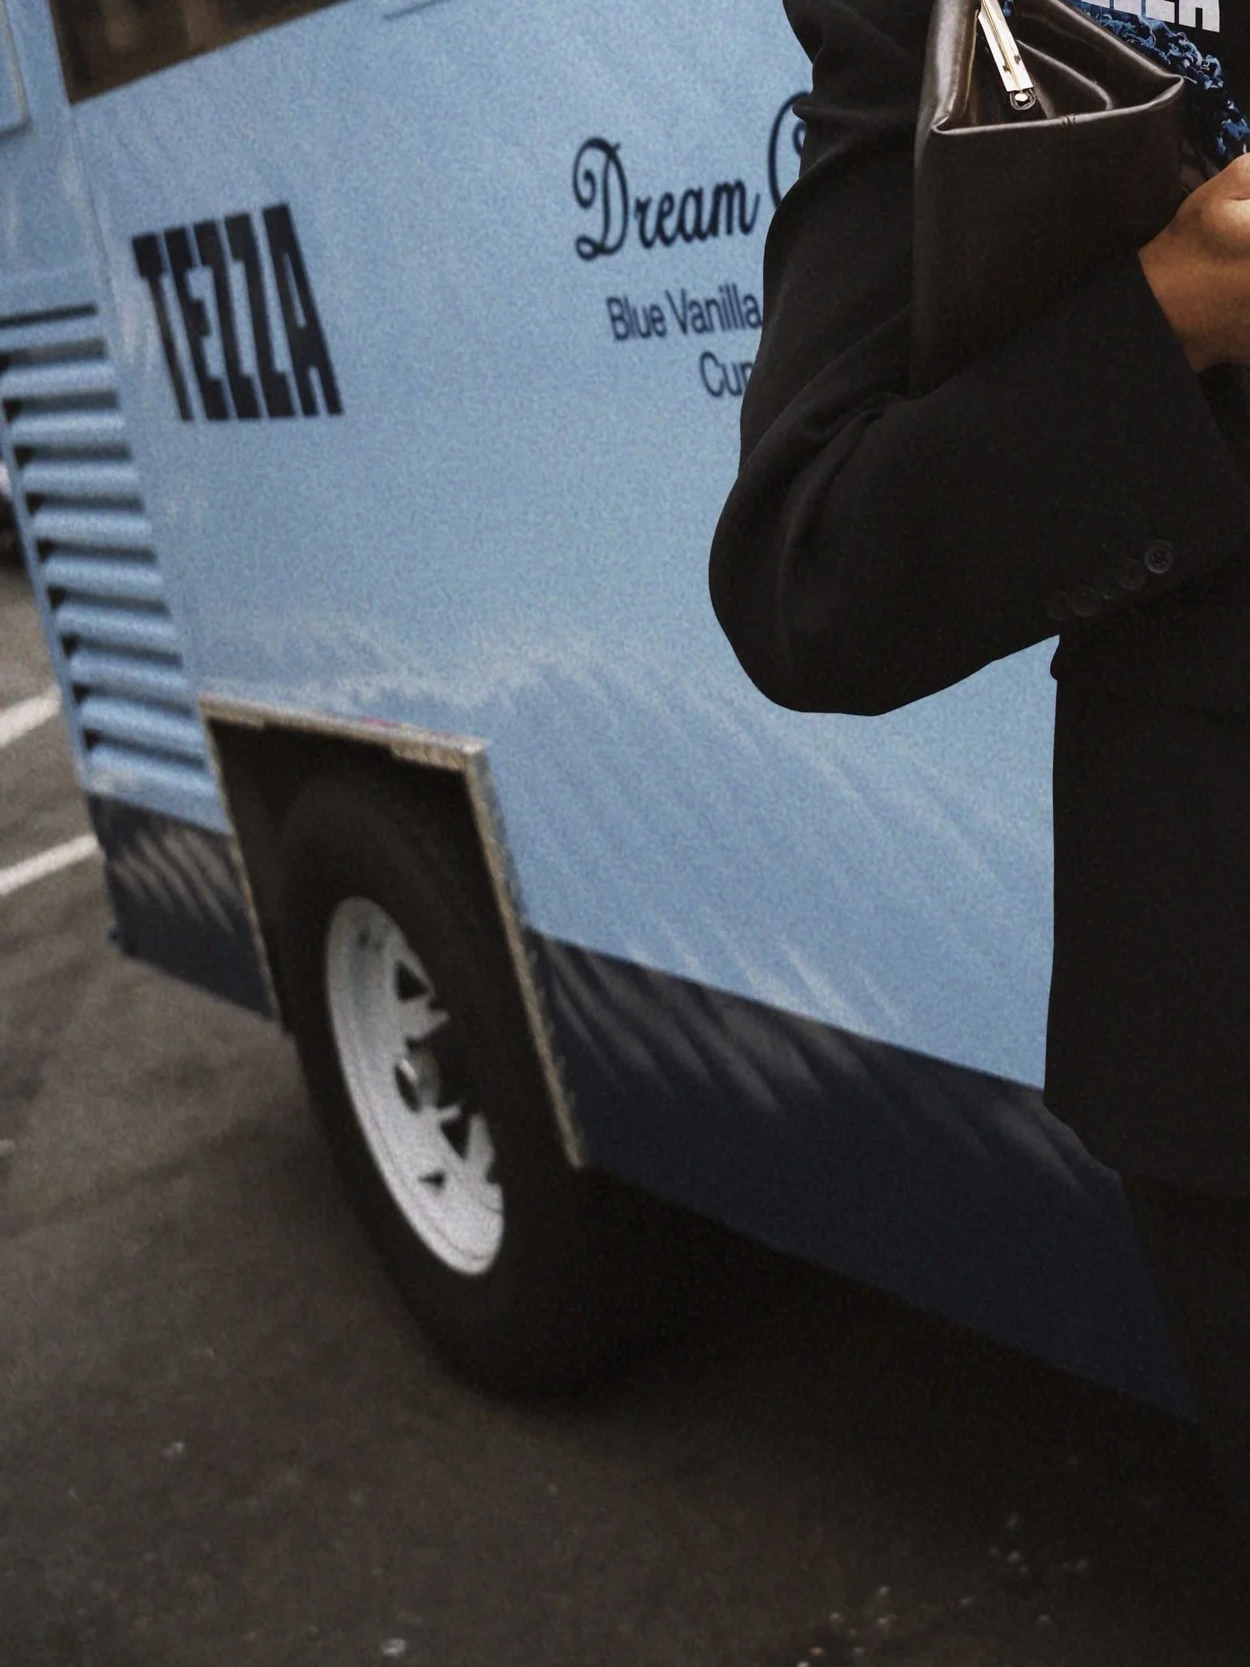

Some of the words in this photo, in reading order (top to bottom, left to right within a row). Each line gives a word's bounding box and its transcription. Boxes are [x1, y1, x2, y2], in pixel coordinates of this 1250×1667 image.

[572, 137, 760, 262] Dream
[131, 202, 344, 422] TEZZA
[606, 293, 667, 341] Blue
[664, 282, 762, 335] Vanilla
